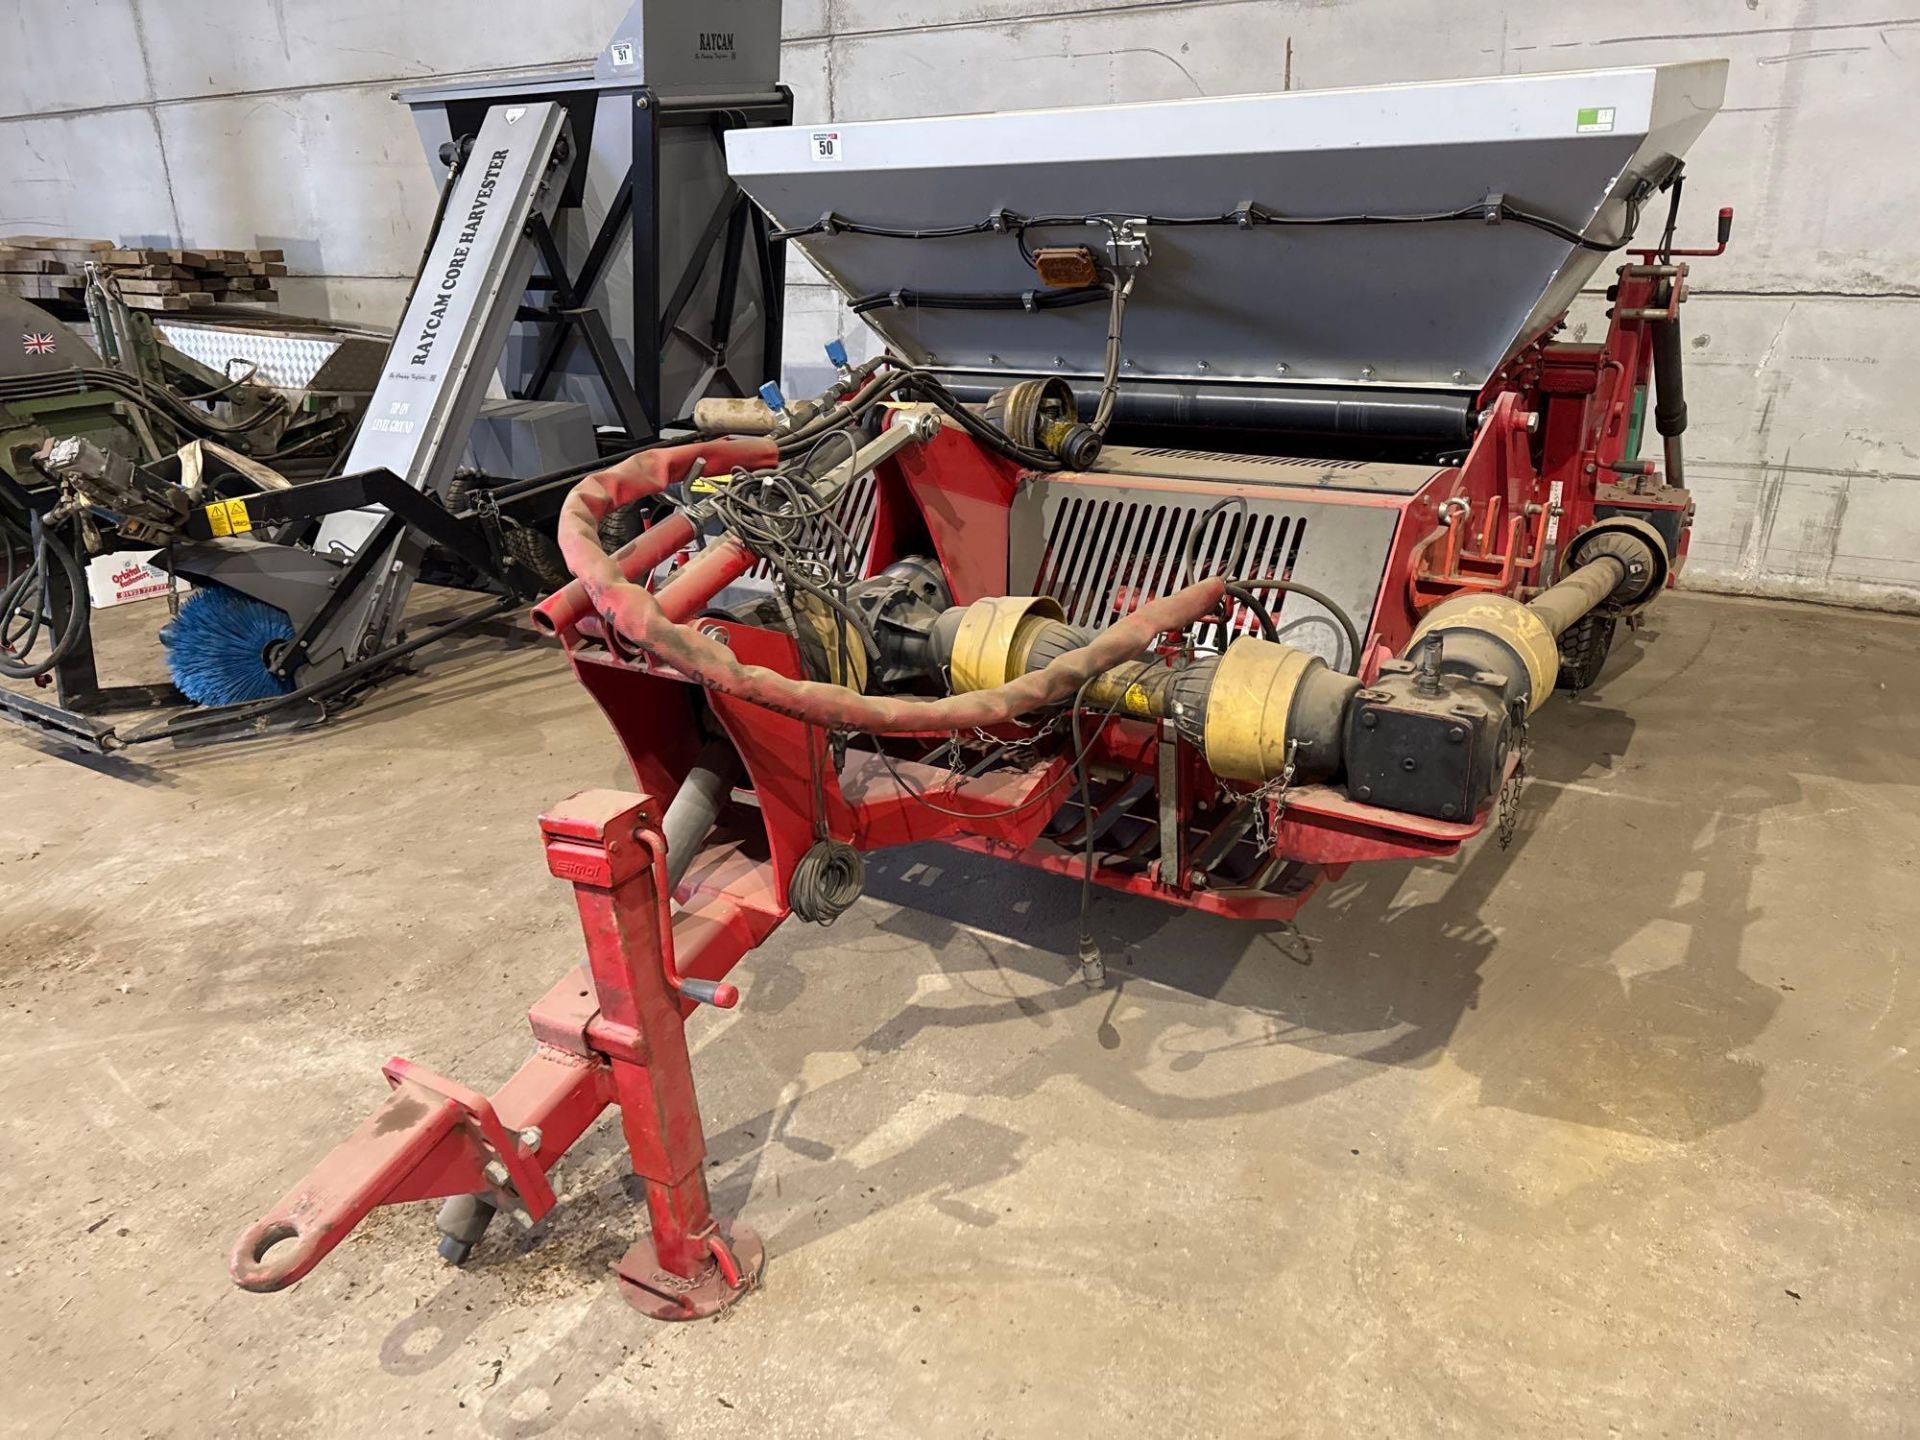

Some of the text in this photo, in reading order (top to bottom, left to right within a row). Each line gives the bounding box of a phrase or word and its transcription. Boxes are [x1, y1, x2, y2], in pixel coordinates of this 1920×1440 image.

[700, 33, 734, 50] RAYCAM
[618, 49, 627, 61] 51
[819, 140, 833, 155] 50
[411, 294, 452, 365] RAYCAM
[442, 247, 470, 290] CORE
[459, 148, 509, 244] HARVESTER
[112, 564, 141, 583] Orbital
